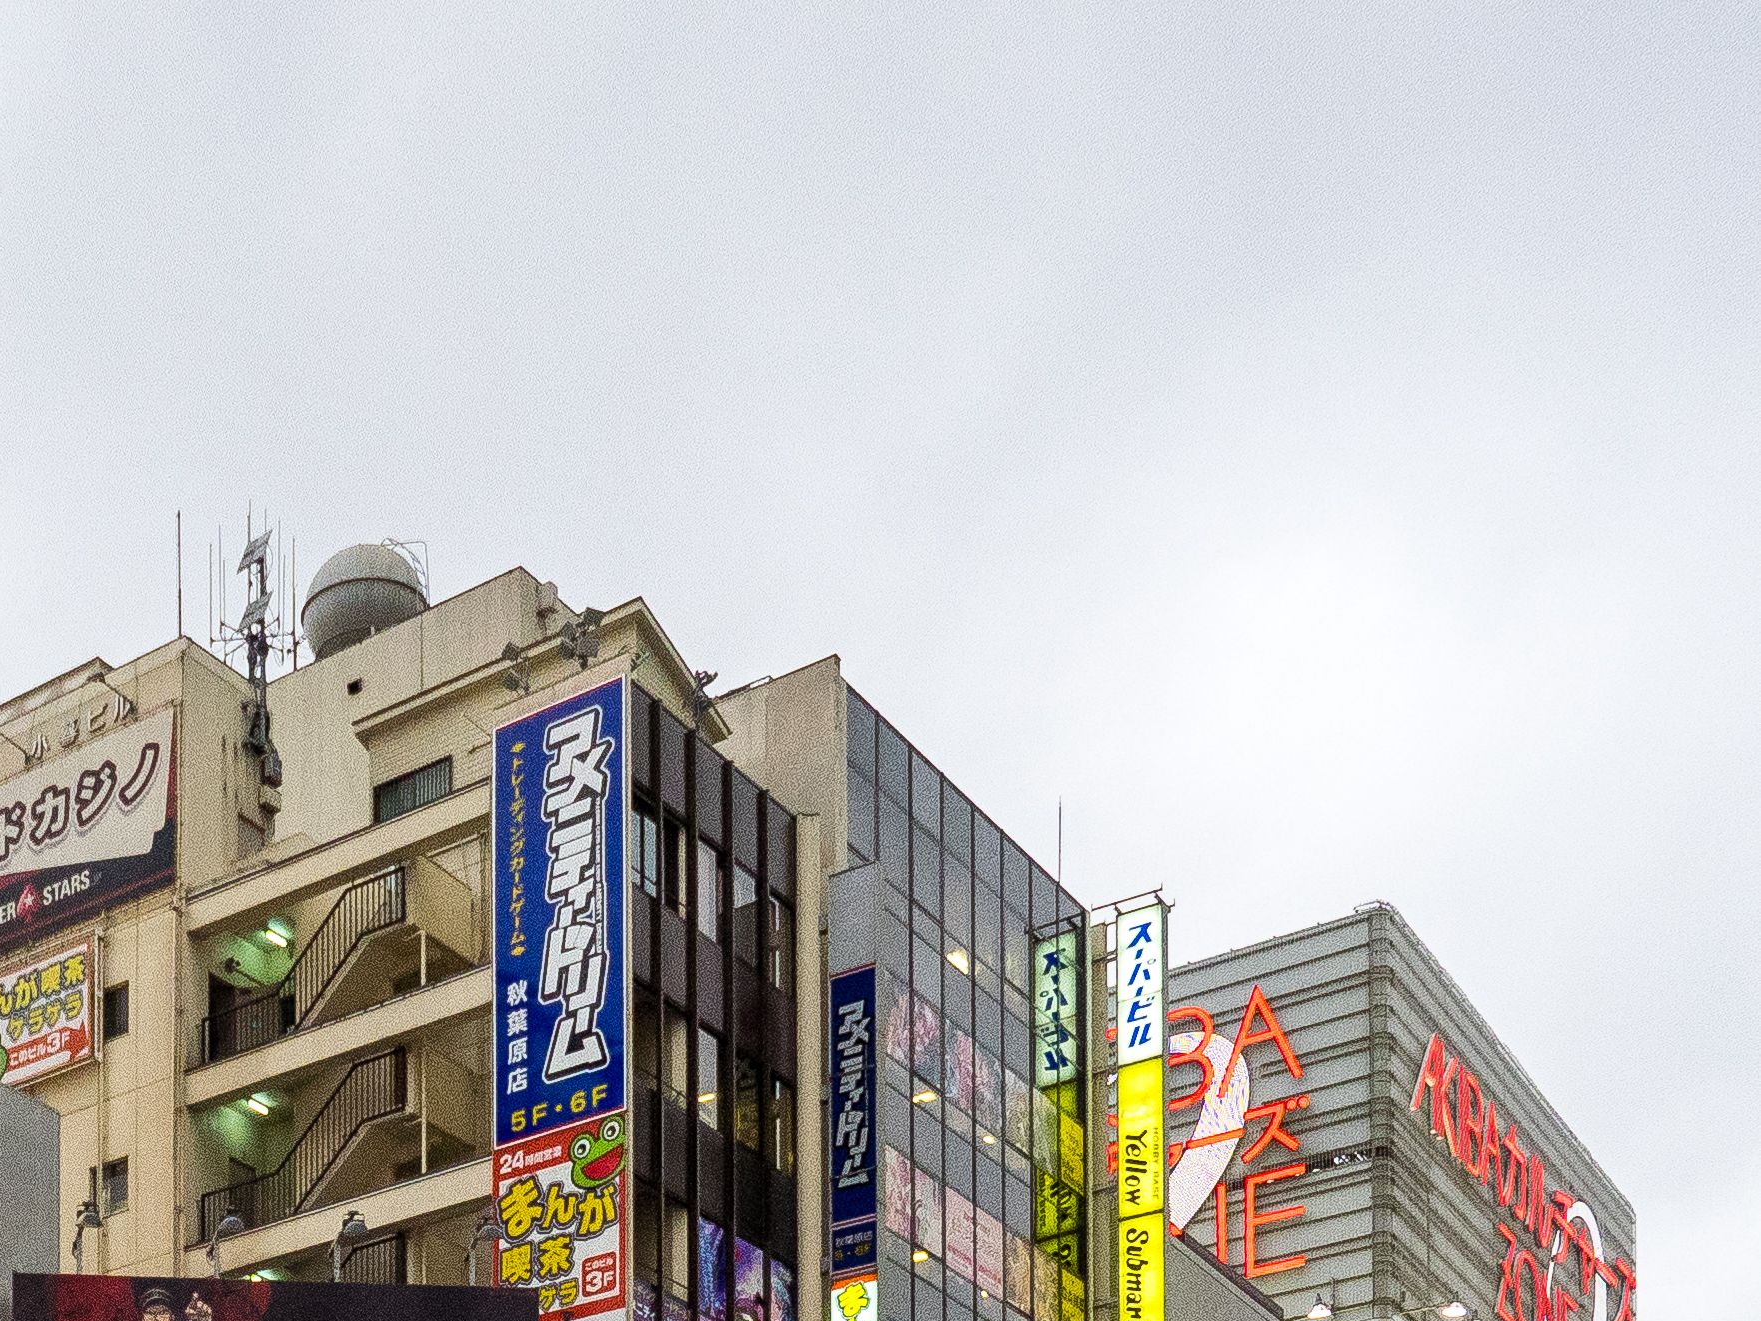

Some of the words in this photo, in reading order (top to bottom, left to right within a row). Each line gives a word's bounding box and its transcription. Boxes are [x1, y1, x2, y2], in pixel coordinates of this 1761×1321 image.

[43, 871, 91, 906] STARS
[1126, 920, 1156, 1048] スーパービル
[507, 982, 528, 1094] 秋葉原店
[1125, 1130, 1150, 1206] Yellow
[496, 1173, 618, 1241] まんが
[586, 1270, 615, 1293] 3F
